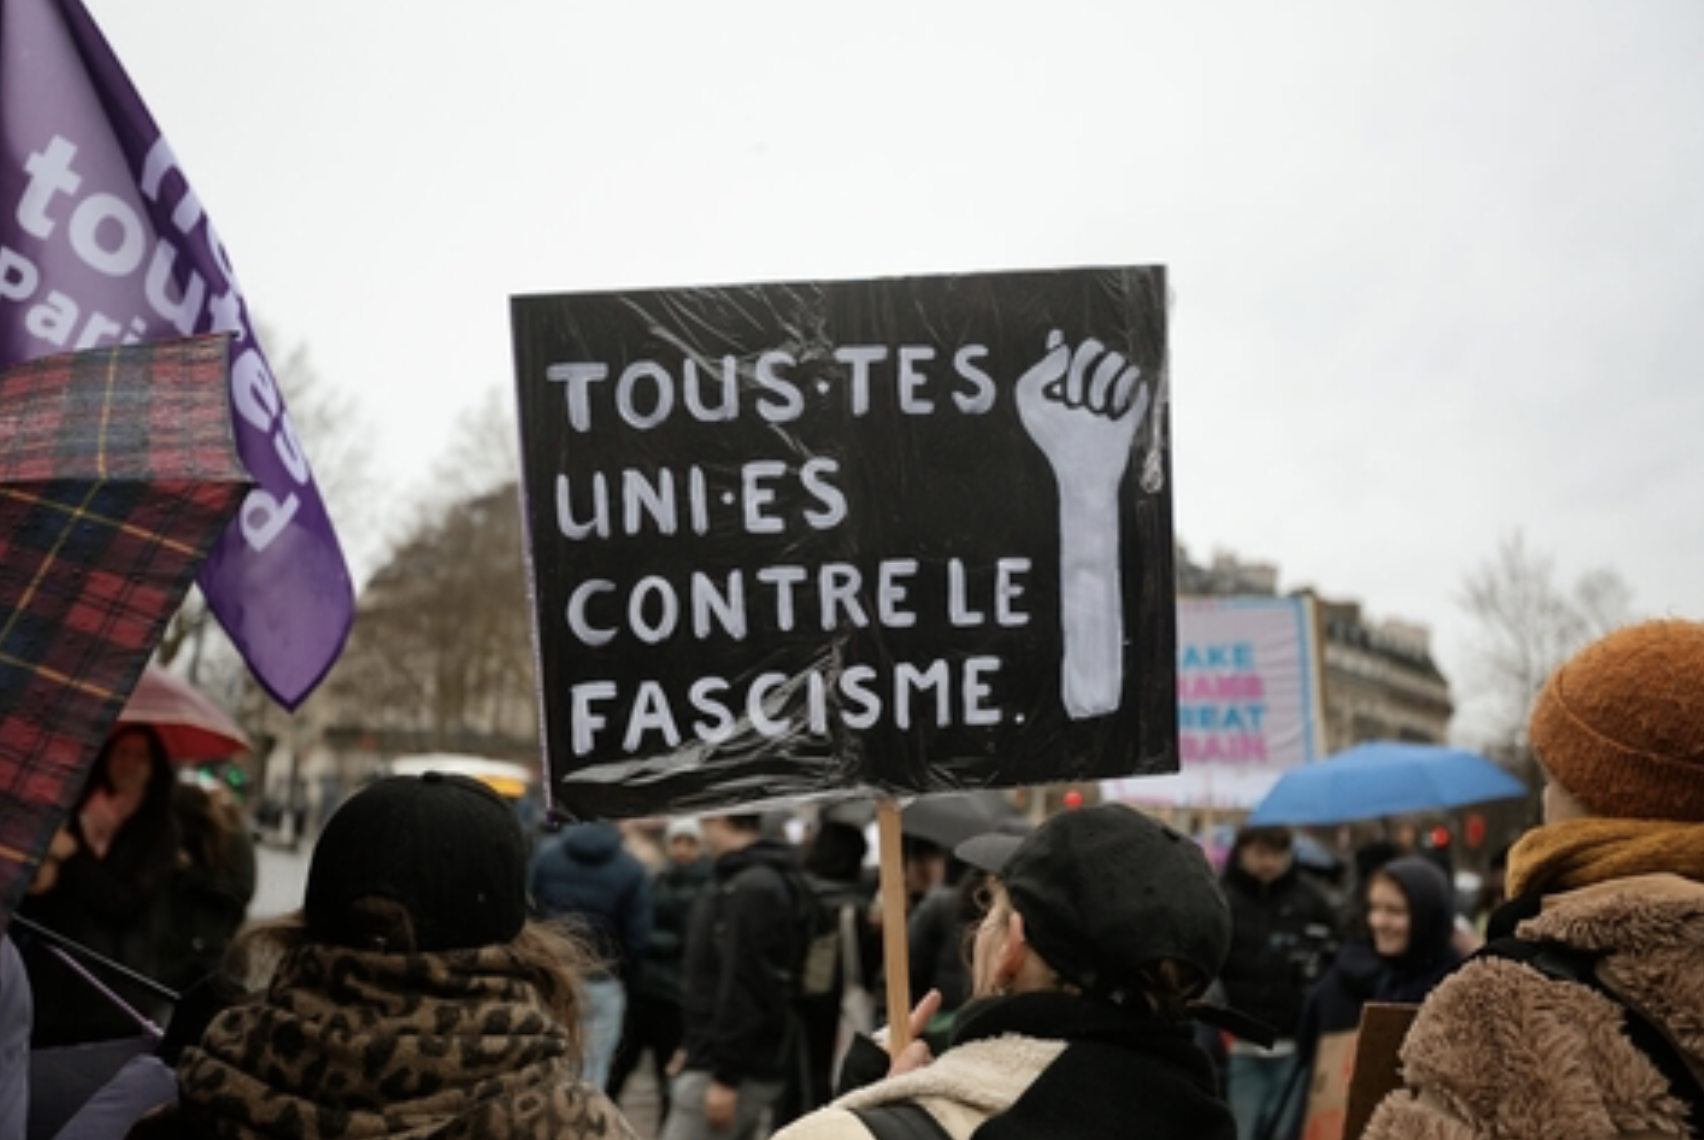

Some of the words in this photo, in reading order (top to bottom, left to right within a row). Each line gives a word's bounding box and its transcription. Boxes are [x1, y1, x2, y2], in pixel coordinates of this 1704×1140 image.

[0, 245, 148, 351] Par
[566, 560, 918, 646] CONTRE
[947, 557, 1032, 627] LE
[1181, 645, 1253, 669] AKE
[570, 656, 1026, 756] FASCISME.
